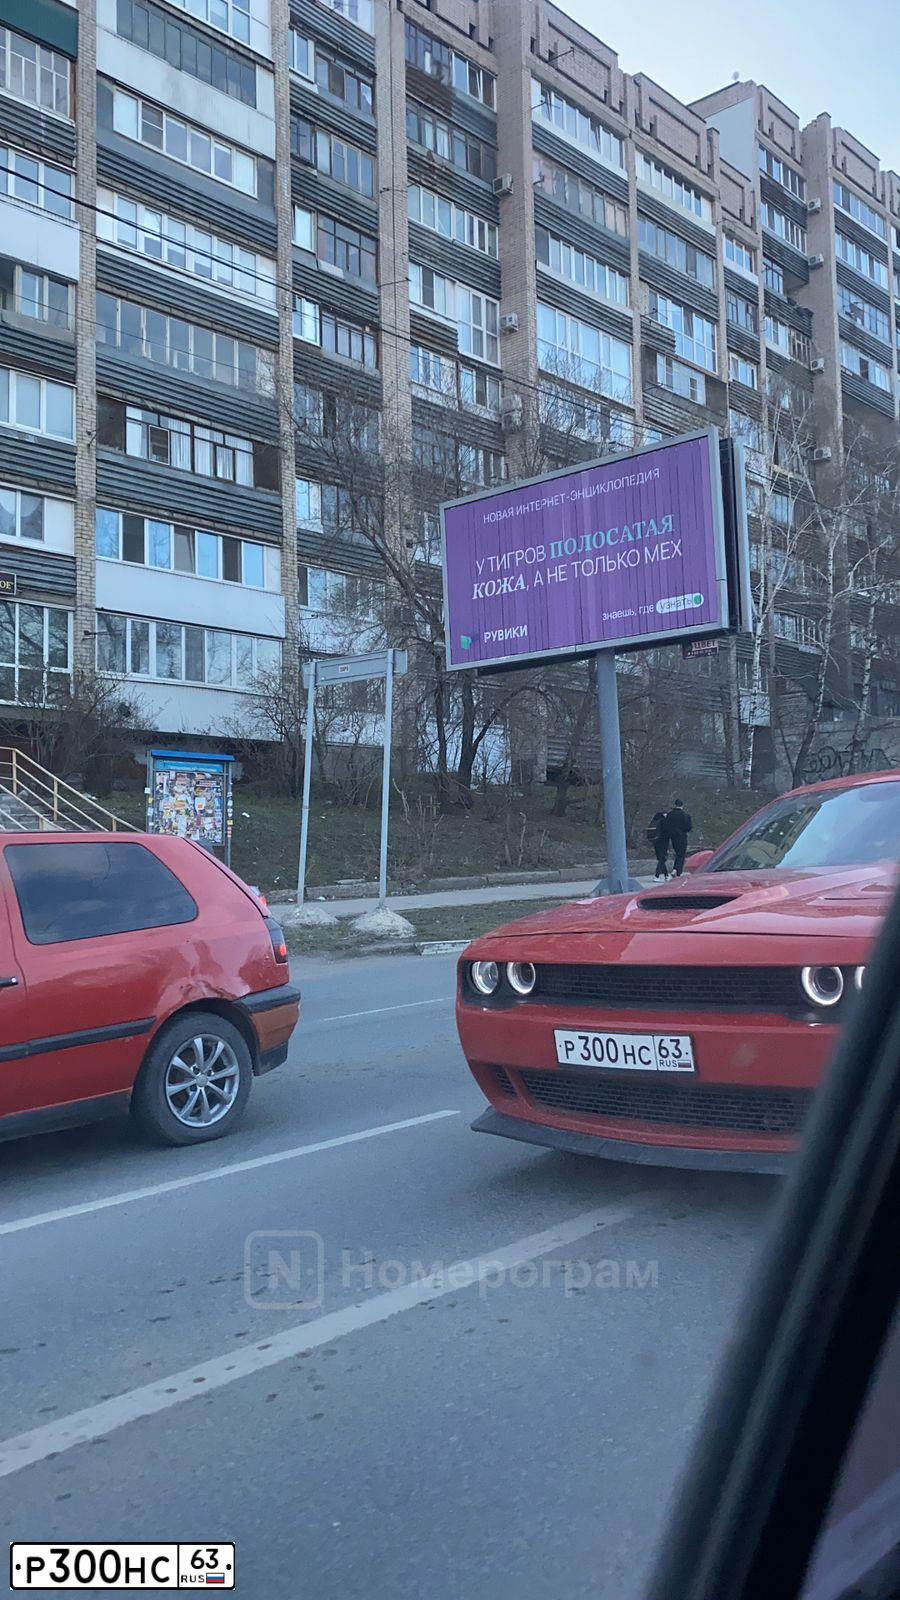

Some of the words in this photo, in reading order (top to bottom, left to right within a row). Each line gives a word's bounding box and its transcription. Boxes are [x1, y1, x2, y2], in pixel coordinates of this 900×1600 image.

[483, 508, 514, 524] НОВАЯ
[516, 467, 660, 516] ИНТЕРНЕТ-ЭНЦИКЛОПЕДИЯ
[475, 560, 485, 575] У
[487, 545, 546, 572] ТИГРОВ
[549, 514, 675, 560] ПОЛОСАТАЯ
[471, 574, 530, 600] КОЖА,
[533, 570, 544, 587] А
[547, 564, 568, 584] НЕ
[571, 549, 640, 578] ТОЛЬКО
[644, 538, 682, 565] МЕХ
[602, 609, 637, 621] знаешь,
[638, 604, 655, 615] где
[483, 624, 528, 643] РУВИКИ
[564, 1035, 652, 1066] Р300НС
[657, 1038, 683, 1059] 63
[659, 1059, 678, 1068] RUS
